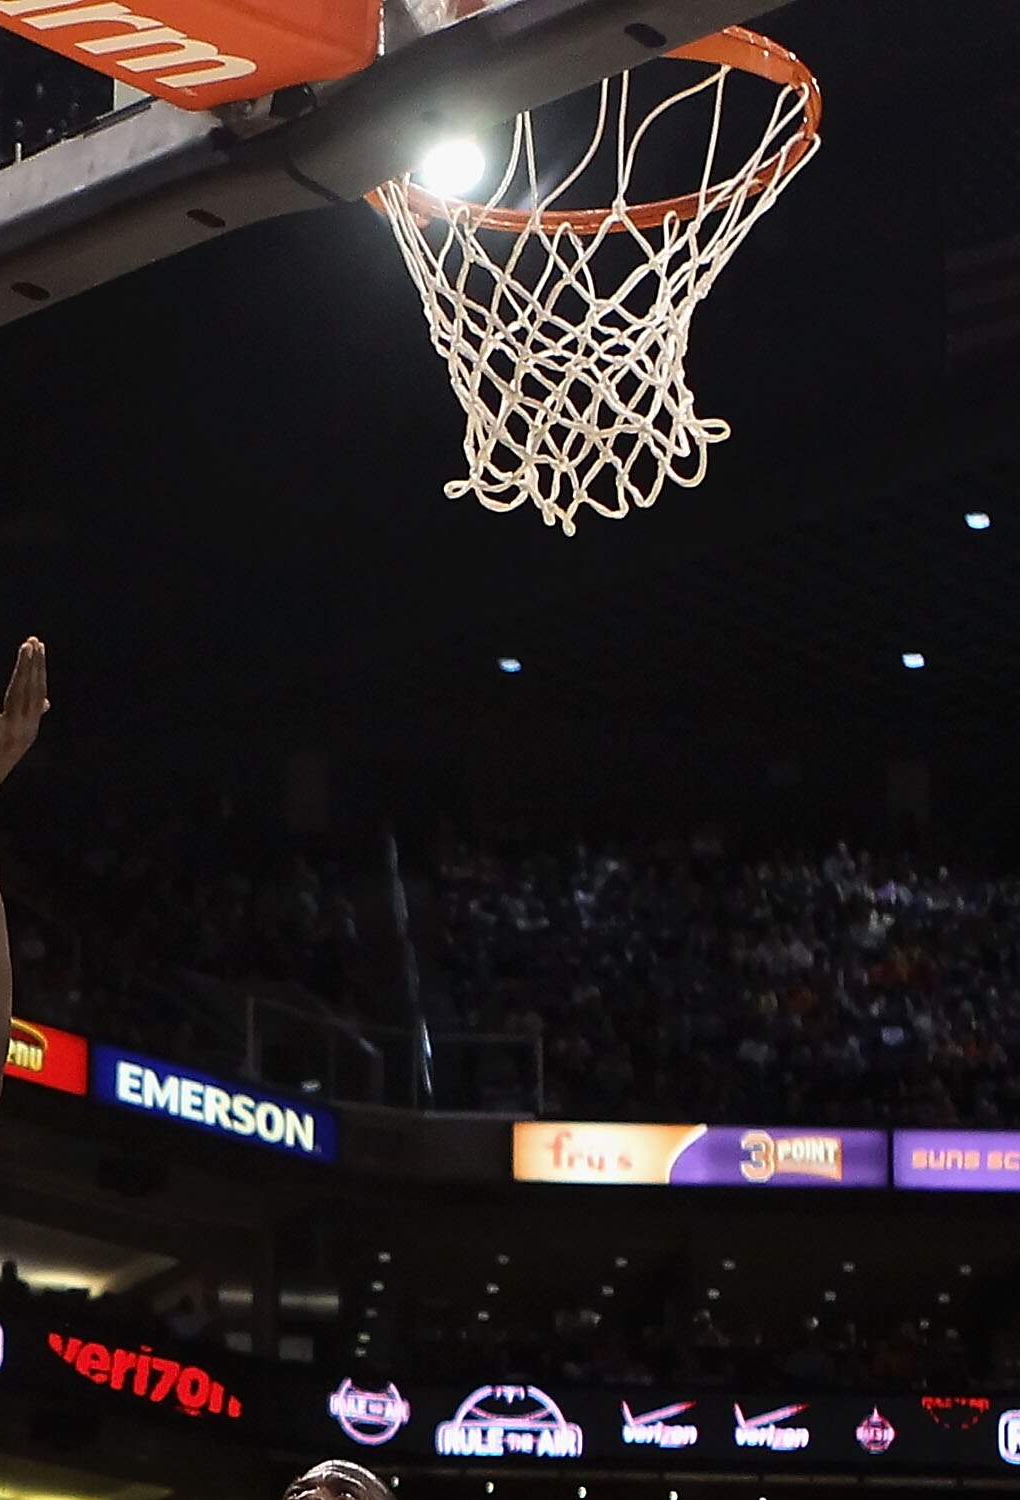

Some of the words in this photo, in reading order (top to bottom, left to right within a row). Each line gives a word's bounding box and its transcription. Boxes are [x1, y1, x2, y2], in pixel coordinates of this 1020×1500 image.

[116, 1060, 315, 1151] EMERSON
[741, 1130, 775, 1183] 3
[777, 1137, 839, 1167] POINT
[443, 1427, 504, 1456] RULE
[536, 1428, 577, 1457] AIR
